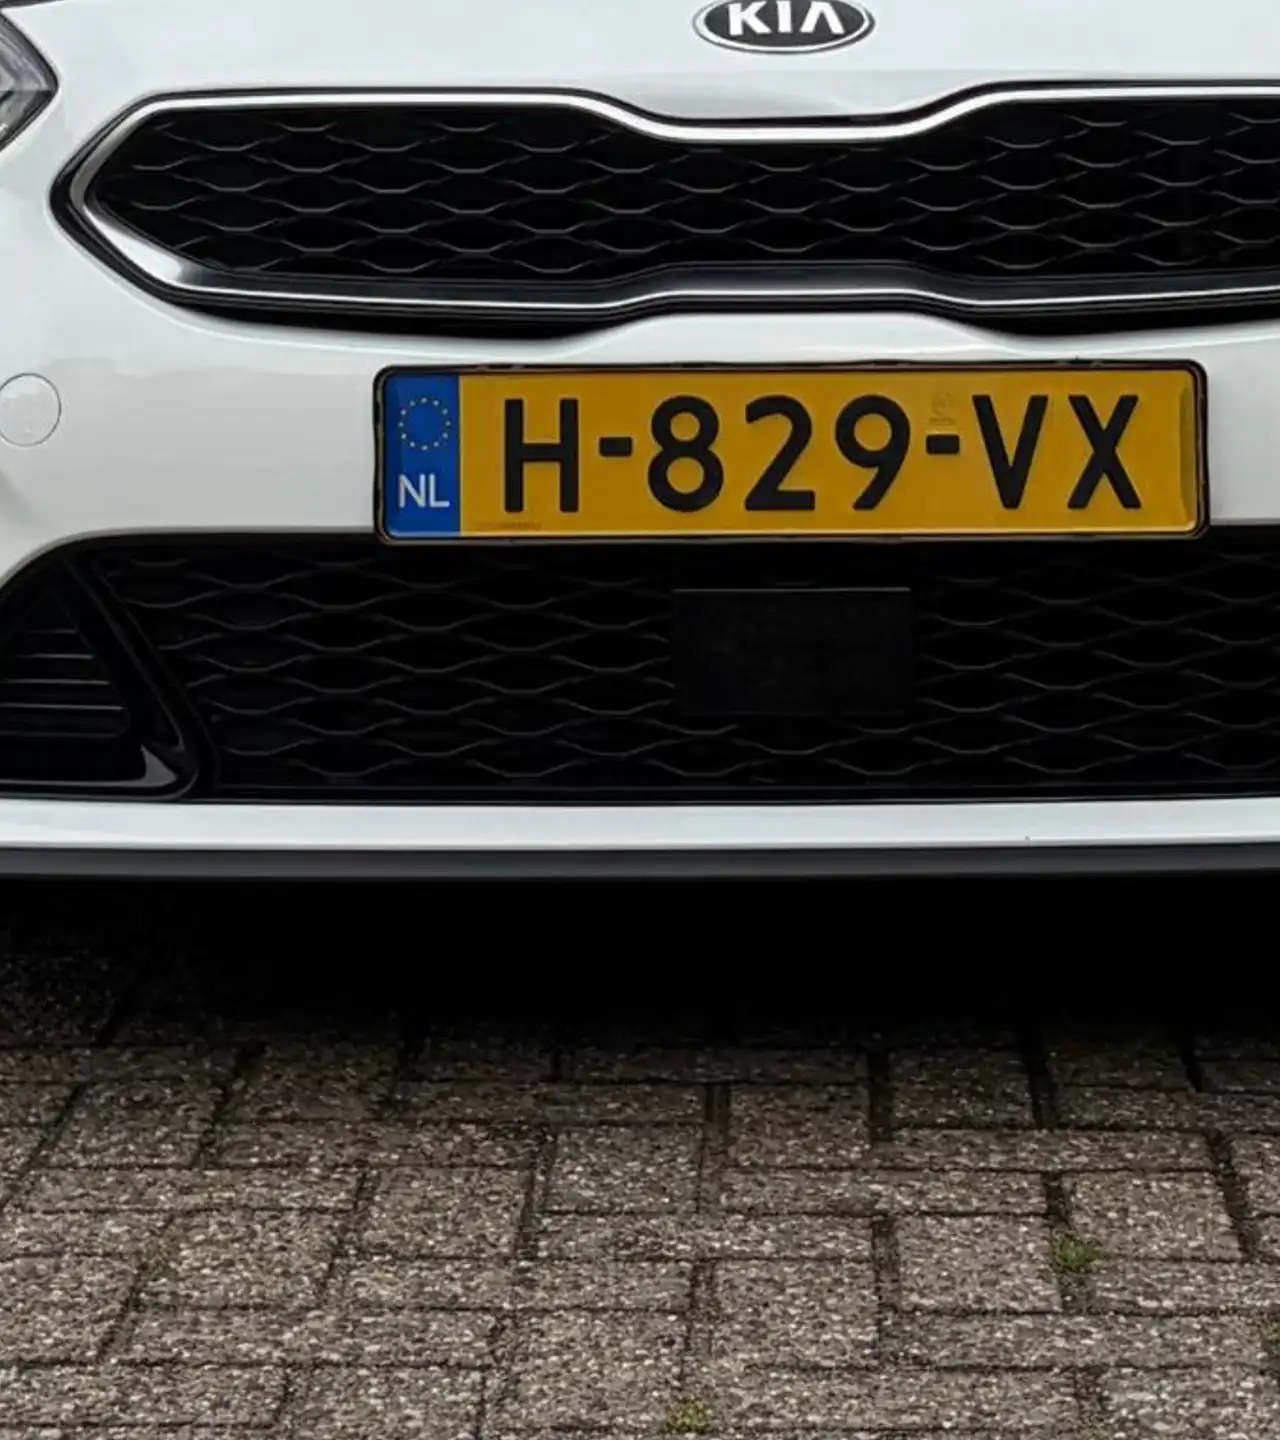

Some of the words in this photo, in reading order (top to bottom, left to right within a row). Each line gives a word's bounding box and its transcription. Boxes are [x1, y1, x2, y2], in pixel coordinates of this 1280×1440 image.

[727, 0, 846, 37] KIA
[503, 394, 1142, 514] H-829-VX
[398, 474, 451, 509] NL
